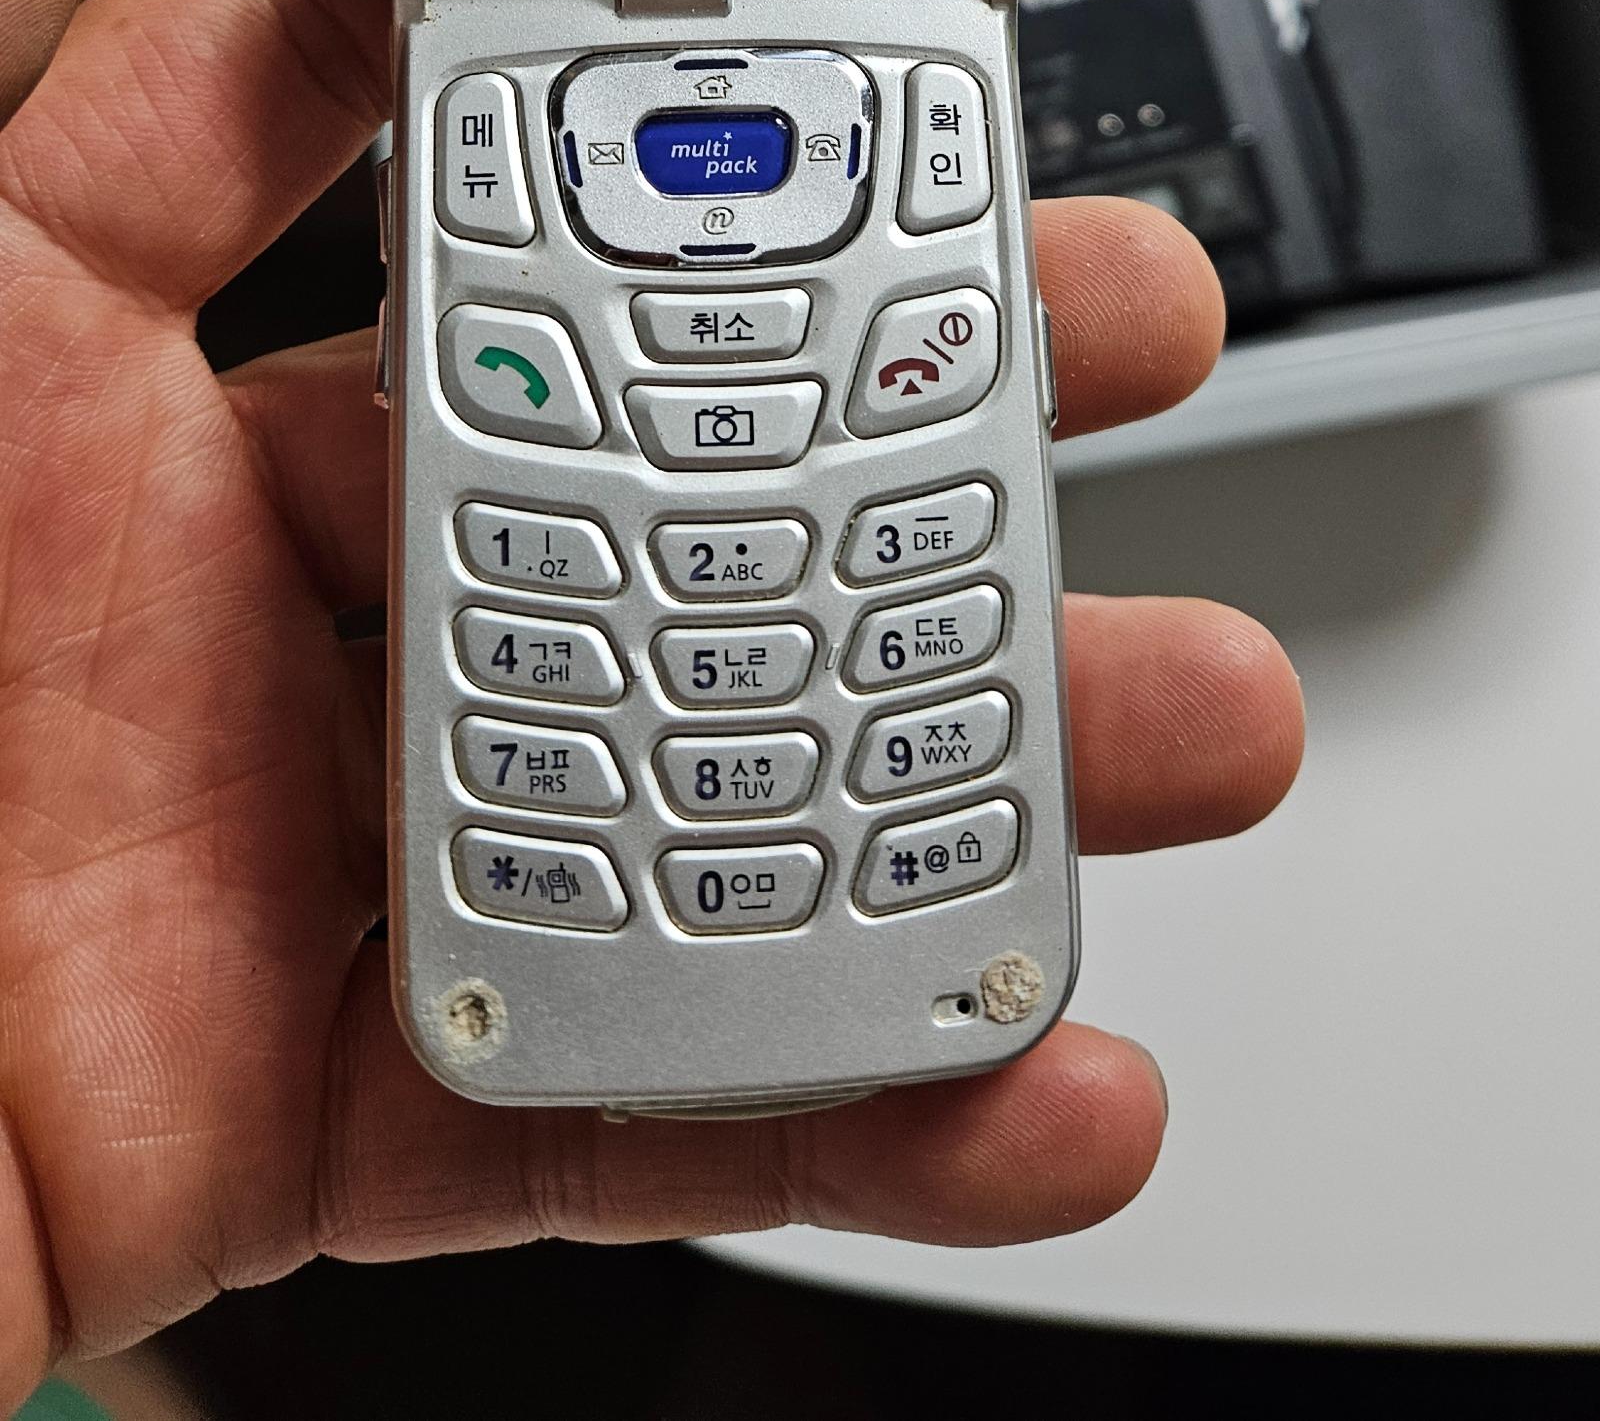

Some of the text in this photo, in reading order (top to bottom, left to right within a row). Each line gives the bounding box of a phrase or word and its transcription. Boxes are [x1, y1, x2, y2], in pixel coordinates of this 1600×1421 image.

[461, 114, 497, 199] 메뉴
[670, 132, 733, 159] multi
[929, 103, 963, 187] 확인
[705, 154, 757, 178] pack
[689, 312, 755, 344] 취소
[492, 528, 509, 566] 1
[875, 524, 902, 564] 3
[913, 530, 954, 551] DEF
[689, 543, 715, 581] 2
[721, 562, 764, 580] ABC
[491, 634, 518, 673] 4
[879, 630, 906, 670] 6
[915, 638, 964, 658] MNO
[532, 664, 570, 683] GHI
[692, 649, 718, 689] 5
[728, 669, 763, 688] JKL
[490, 743, 518, 786] 7
[886, 736, 913, 777] 9
[921, 745, 972, 764] WXY
[529, 774, 567, 794] PRS
[695, 758, 721, 800] 8
[730, 781, 774, 799] TUV
[697, 871, 724, 913] 0
